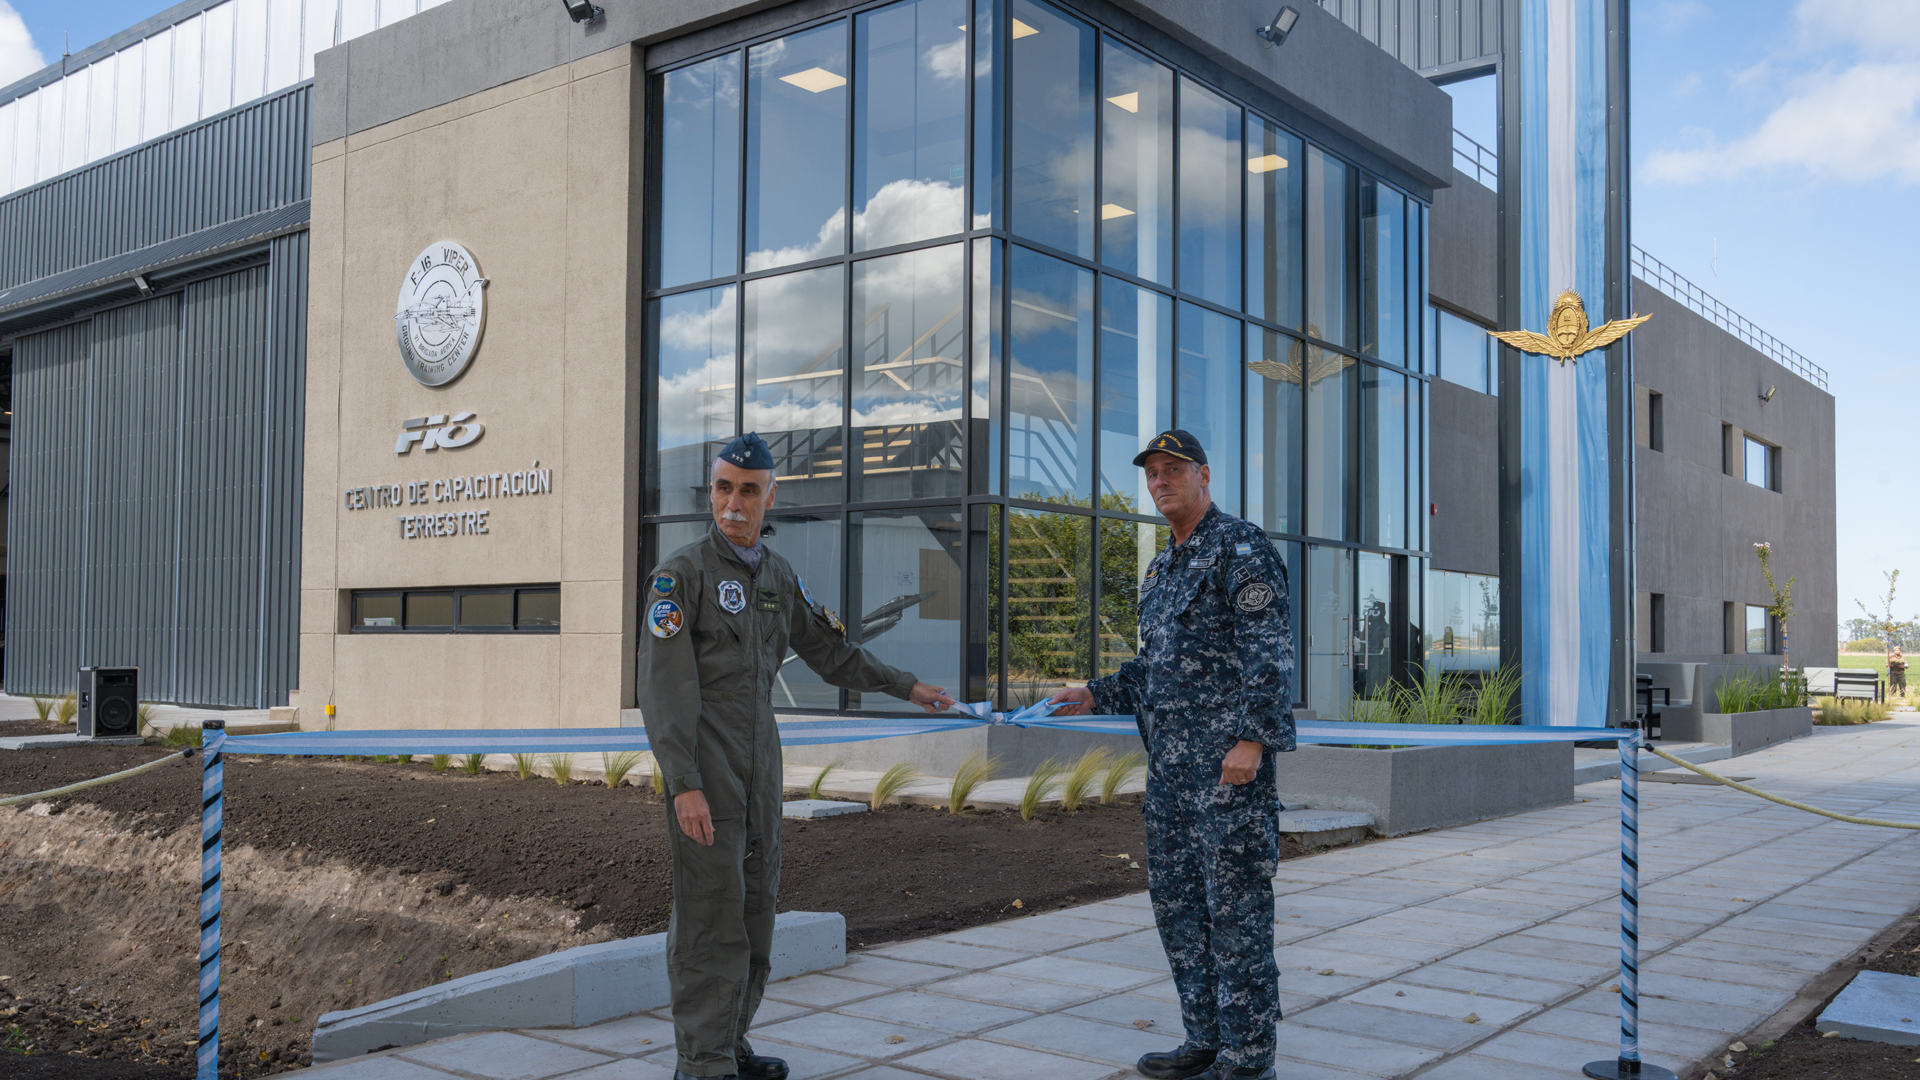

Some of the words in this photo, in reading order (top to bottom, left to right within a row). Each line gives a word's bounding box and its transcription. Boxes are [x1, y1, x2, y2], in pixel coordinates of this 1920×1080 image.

[411, 255, 431, 285] F-16
[402, 325, 415, 361] GROUND
[417, 360, 445, 374] TRAINING
[448, 331, 469, 366] CENTER
[418, 343, 437, 357] BRIGADA
[393, 411, 485, 454] F16
[344, 483, 403, 510] CENTRO
[407, 480, 429, 504] DE
[433, 459, 553, 502] CAPACITACIÓN
[396, 510, 489, 539] TERRESTRE
